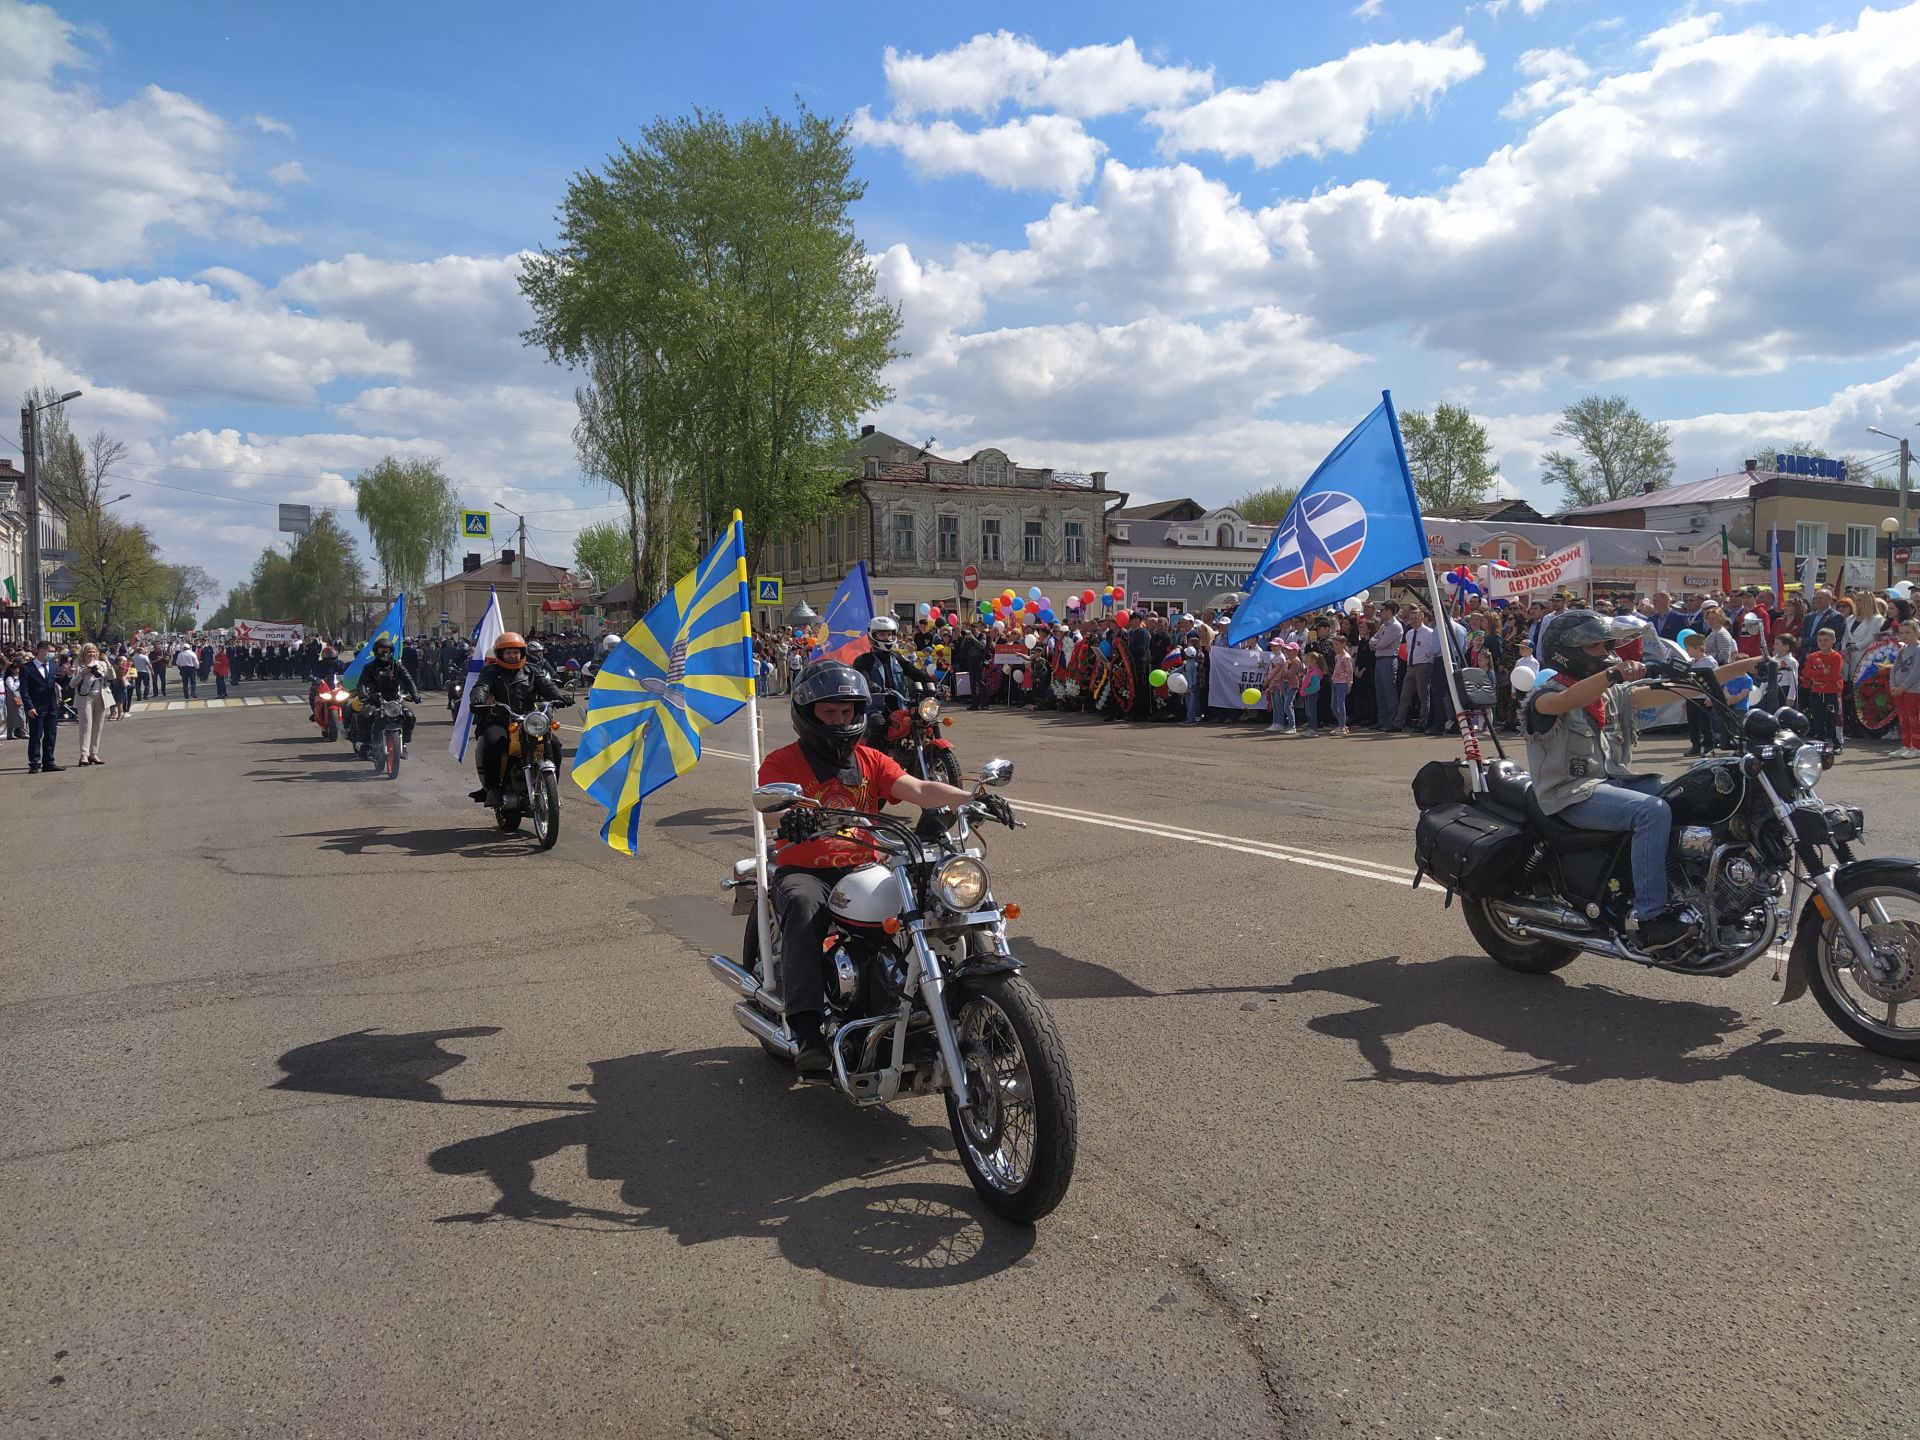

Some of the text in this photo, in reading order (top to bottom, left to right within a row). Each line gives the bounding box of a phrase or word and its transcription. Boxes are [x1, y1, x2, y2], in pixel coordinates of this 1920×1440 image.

[1776, 453, 1846, 481] SAMSUNG
[1426, 534, 1445, 545] ИТА
[1192, 572, 1251, 590] AVENU
[1508, 568, 1562, 593] АВТОДОР
[1241, 671, 1265, 684] БЕЛ
